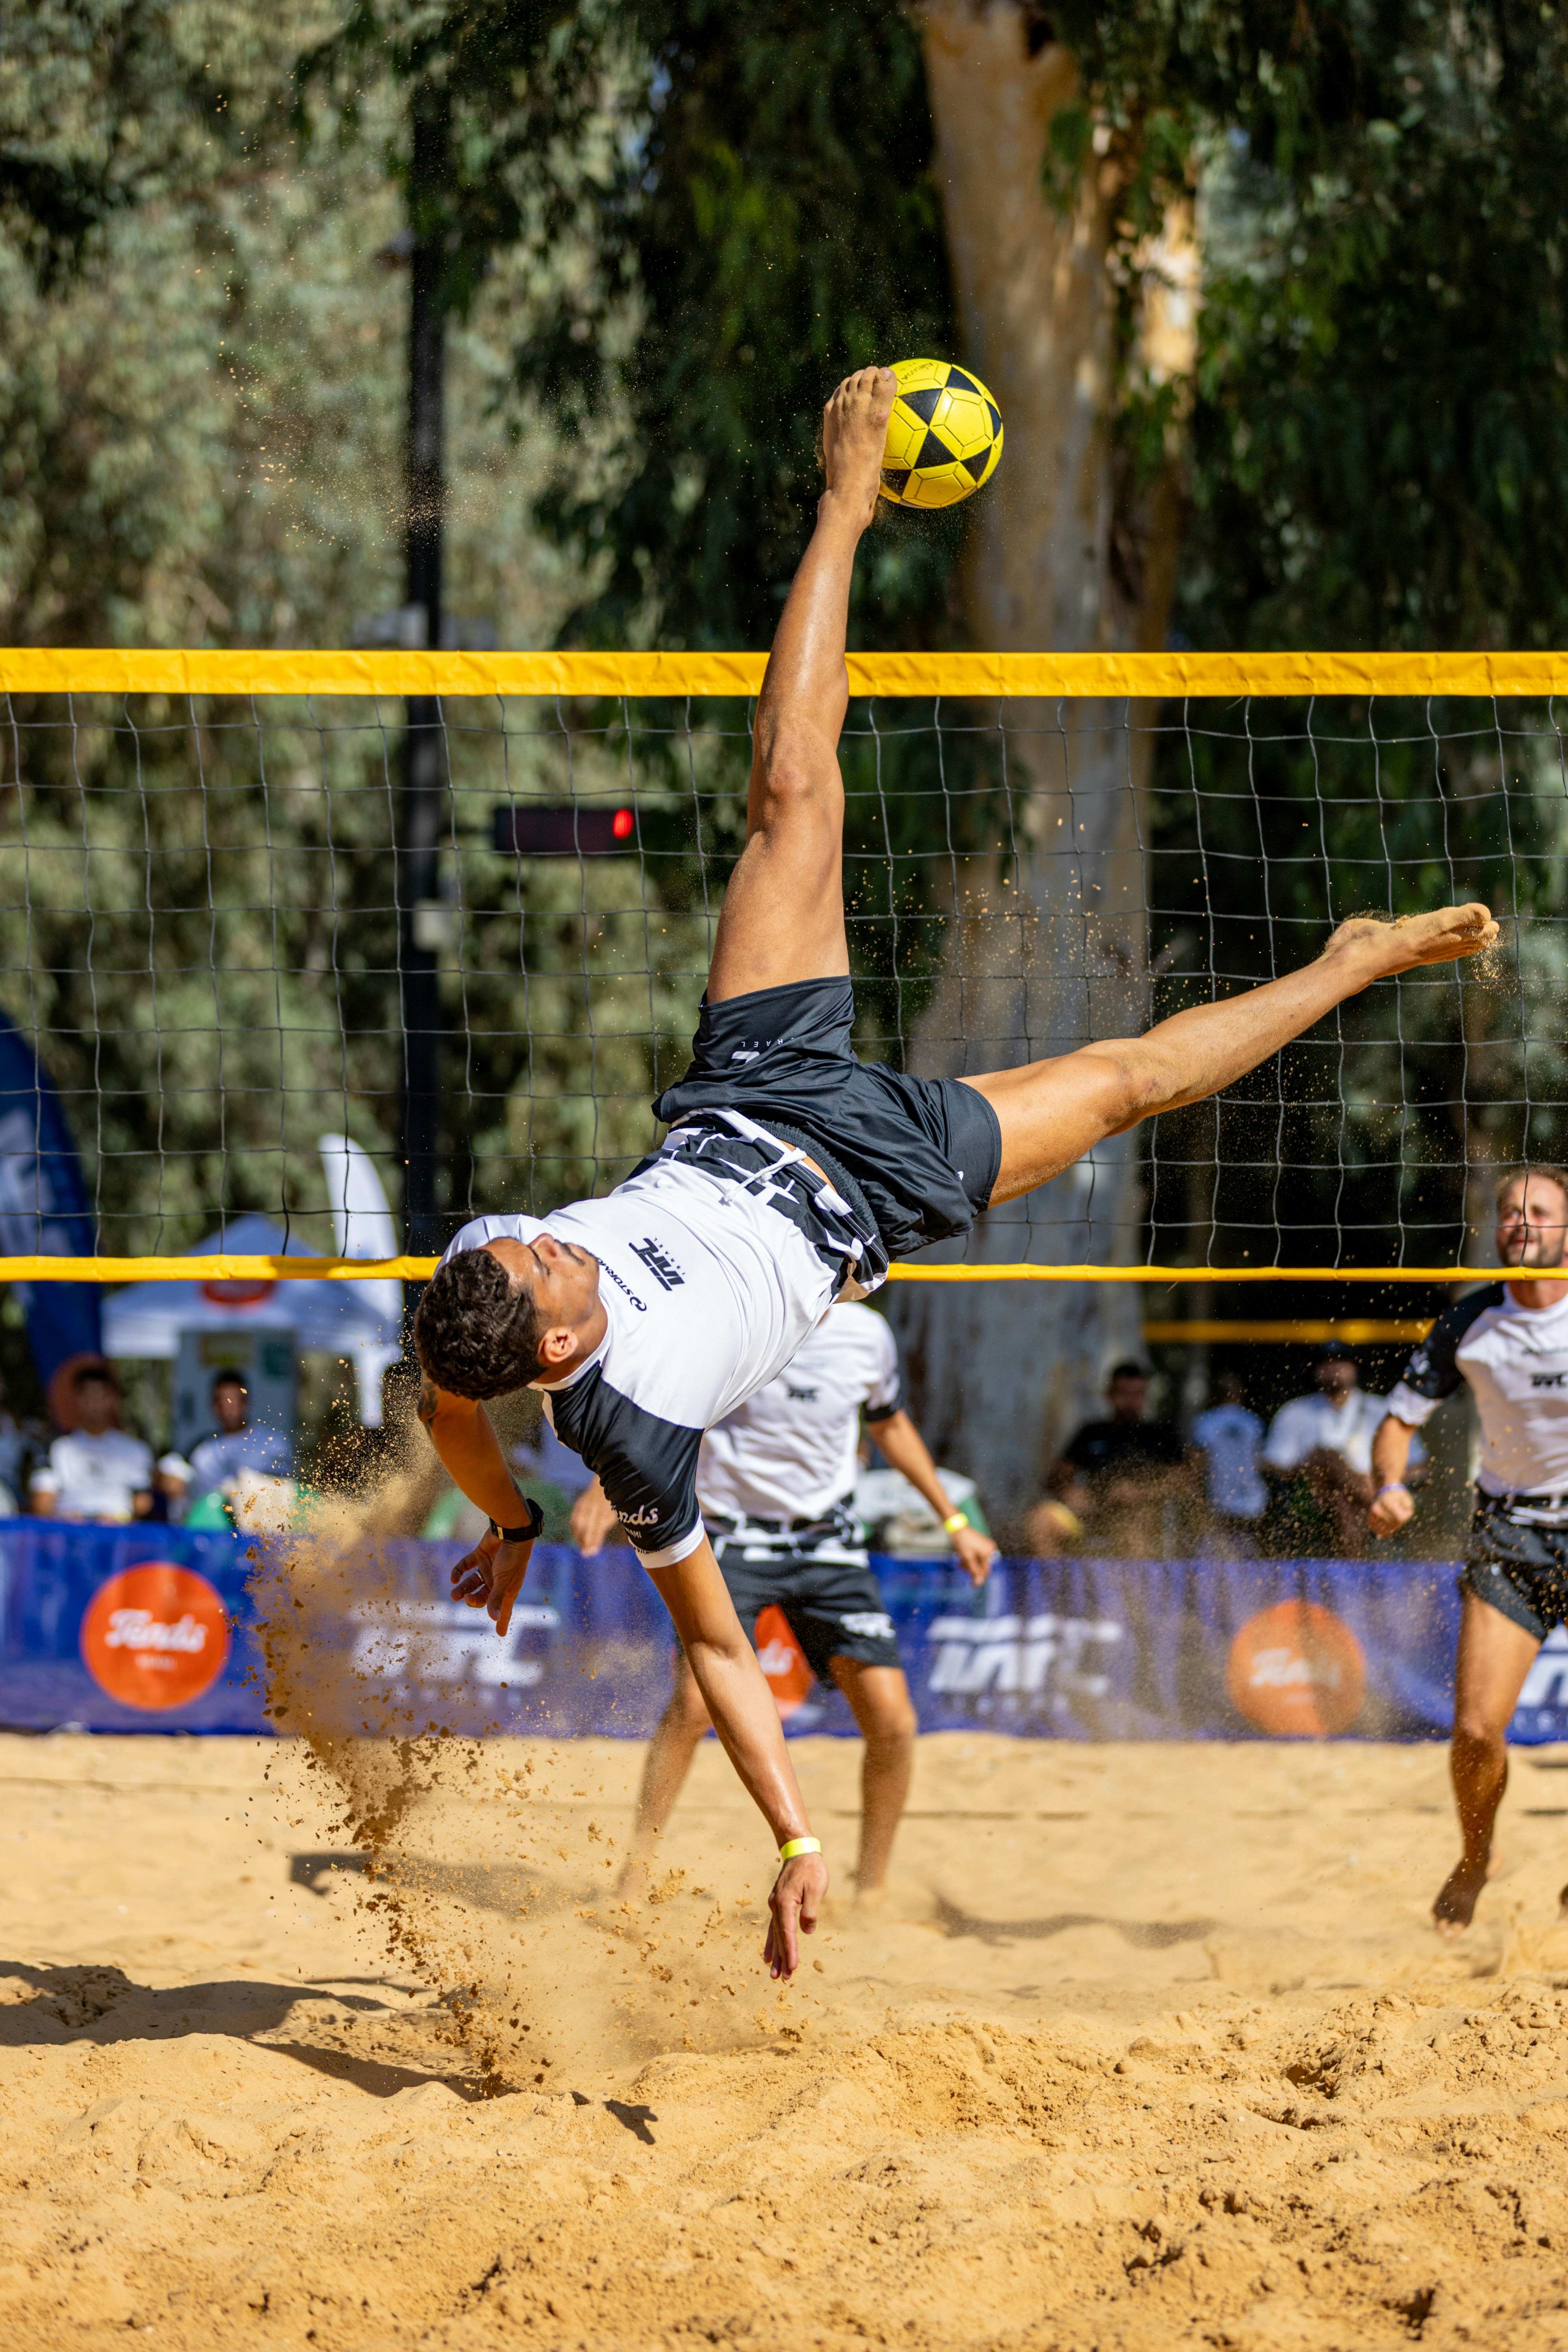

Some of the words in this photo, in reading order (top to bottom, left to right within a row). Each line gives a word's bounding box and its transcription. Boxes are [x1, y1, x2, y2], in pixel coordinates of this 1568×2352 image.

[741, 1037, 794, 1048] RAEL
[654, 1237, 685, 1275] ISRAEL
[596, 1257, 634, 1295] STORMO
